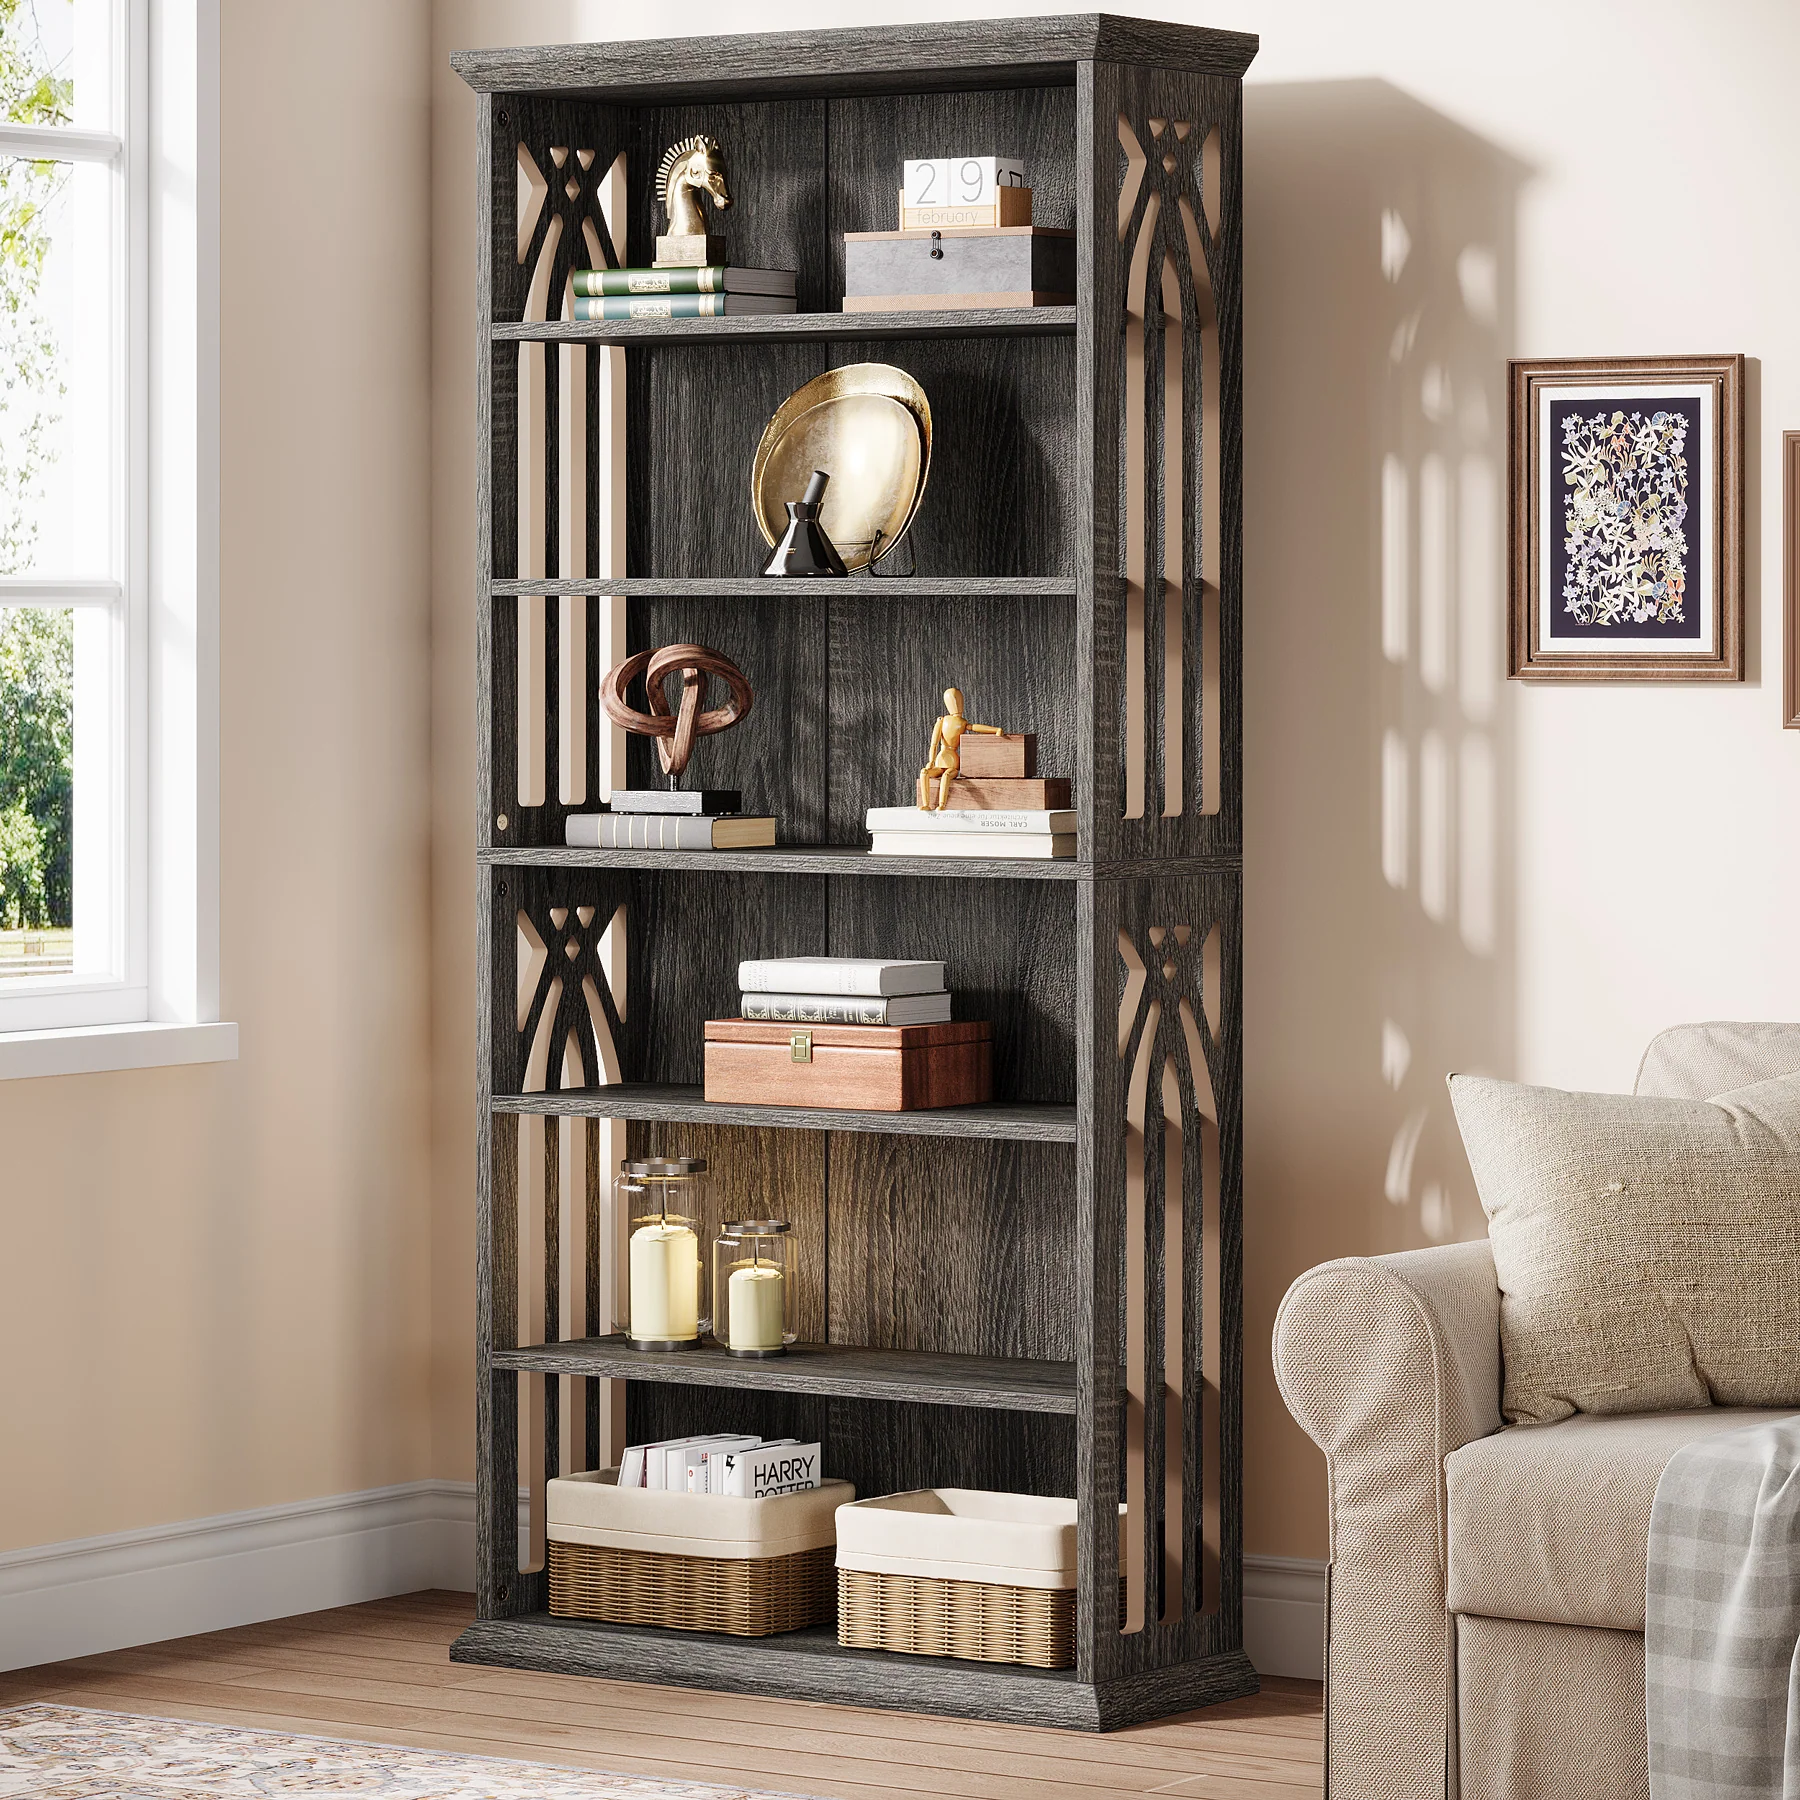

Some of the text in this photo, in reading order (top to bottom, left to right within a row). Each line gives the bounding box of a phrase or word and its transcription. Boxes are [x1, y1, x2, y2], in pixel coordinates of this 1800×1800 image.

[917, 207, 979, 226] february
[980, 820, 1006, 828] MOSER
[754, 1454, 815, 1488] HARRY
